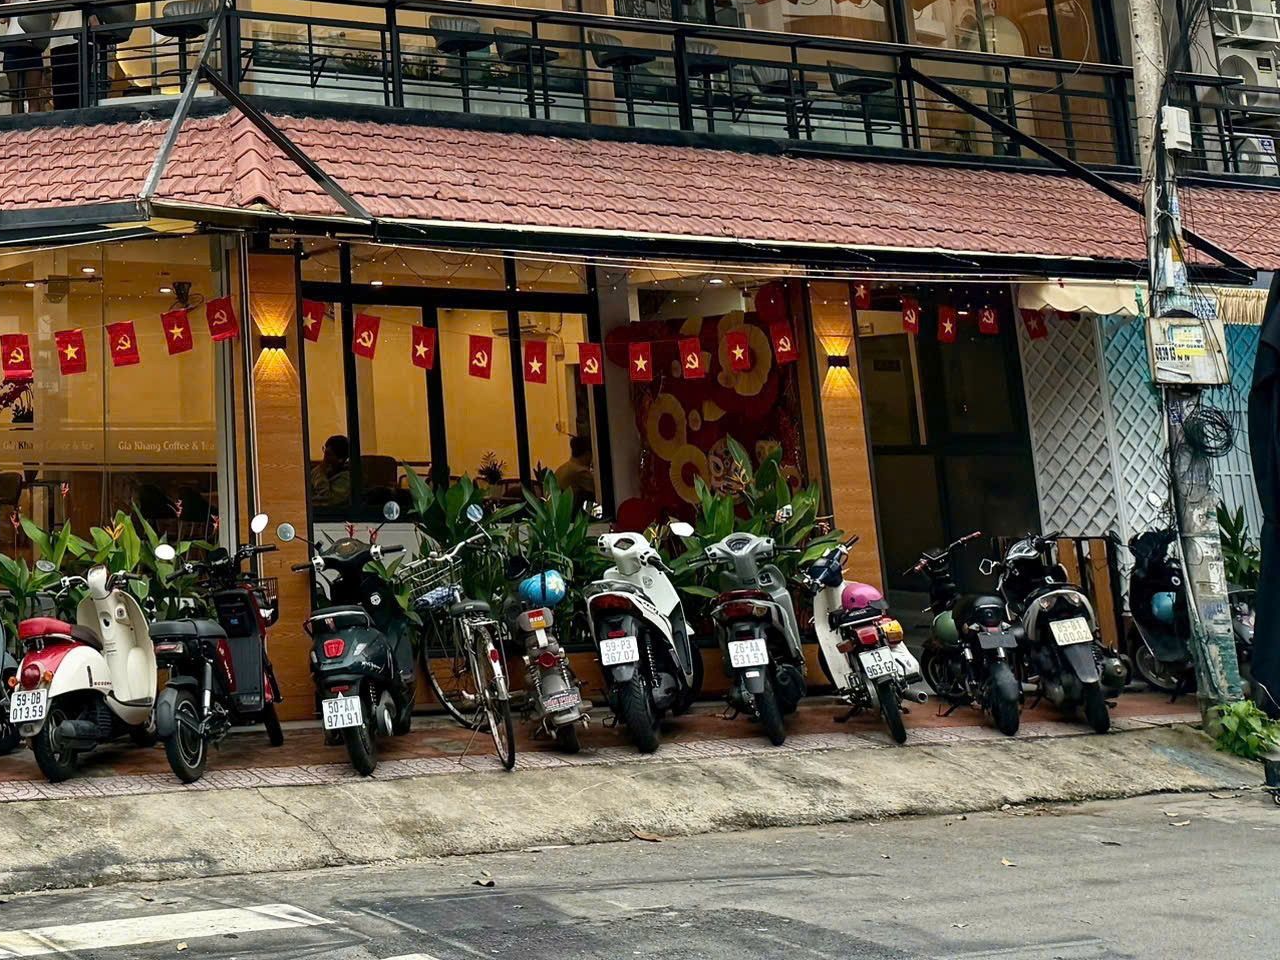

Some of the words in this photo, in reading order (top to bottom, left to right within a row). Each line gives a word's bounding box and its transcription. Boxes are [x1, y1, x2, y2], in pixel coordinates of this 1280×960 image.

[118, 440, 132, 451] Gia
[134, 440, 161, 453] Khang
[163, 440, 190, 451] Coffee
[605, 639, 632, 652] 59-P3
[870, 651, 883, 663] 13
[16, 691, 41, 706] 59-DB
[12, 705, 44, 720] 013.59
[327, 699, 355, 715] 50-AA
[327, 711, 359, 728] 971.91
